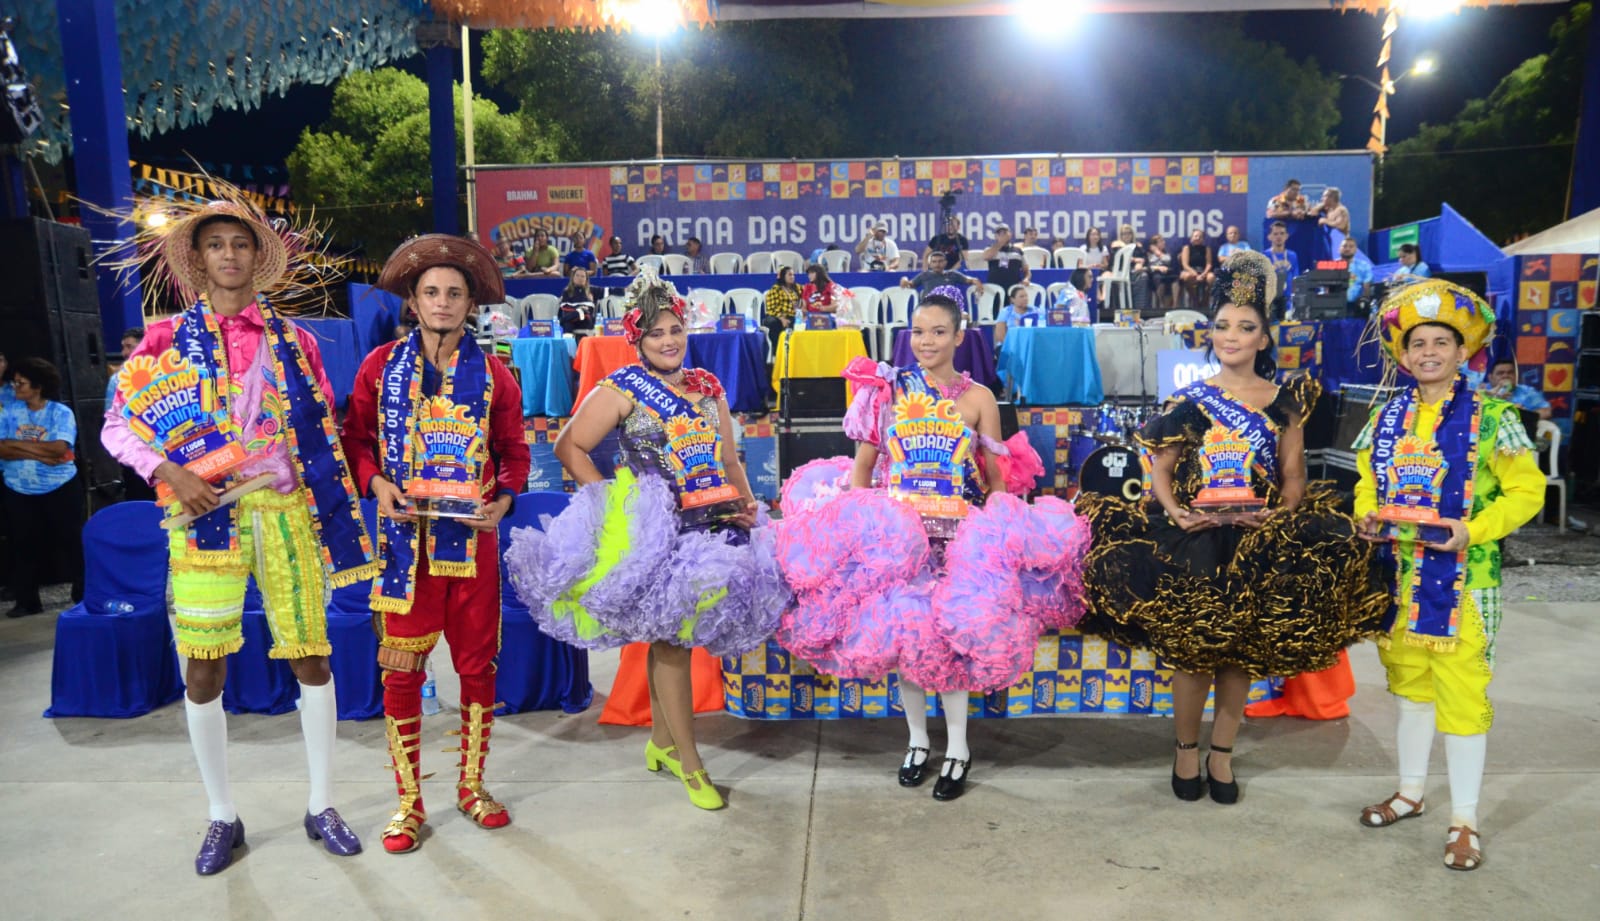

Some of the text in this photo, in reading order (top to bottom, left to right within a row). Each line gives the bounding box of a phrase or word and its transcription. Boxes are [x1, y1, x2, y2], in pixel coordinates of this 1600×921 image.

[506, 190, 538, 201] BRAHMA
[637, 209, 1224, 247] ARENA DAS QUADRILAS DEODETE DIAS
[127, 368, 200, 414] MOSSORÓ
[625, 373, 679, 415] PRINCESA
[142, 387, 199, 425] CIDADE
[155, 404, 201, 435] JUNINA
[386, 409, 399, 428] DO
[187, 438, 206, 452] LUGAR
[386, 433, 399, 463] MCJ
[424, 432, 470, 447] CIDADE
[902, 435, 957, 452] CIDADE
[1248, 429, 1266, 450] DO
[1377, 439, 1392, 457] DO
[428, 444, 465, 457] JUNINA
[678, 443, 713, 460] CIDADE
[907, 449, 950, 463] JUNINA
[1209, 451, 1245, 462] CIDADE
